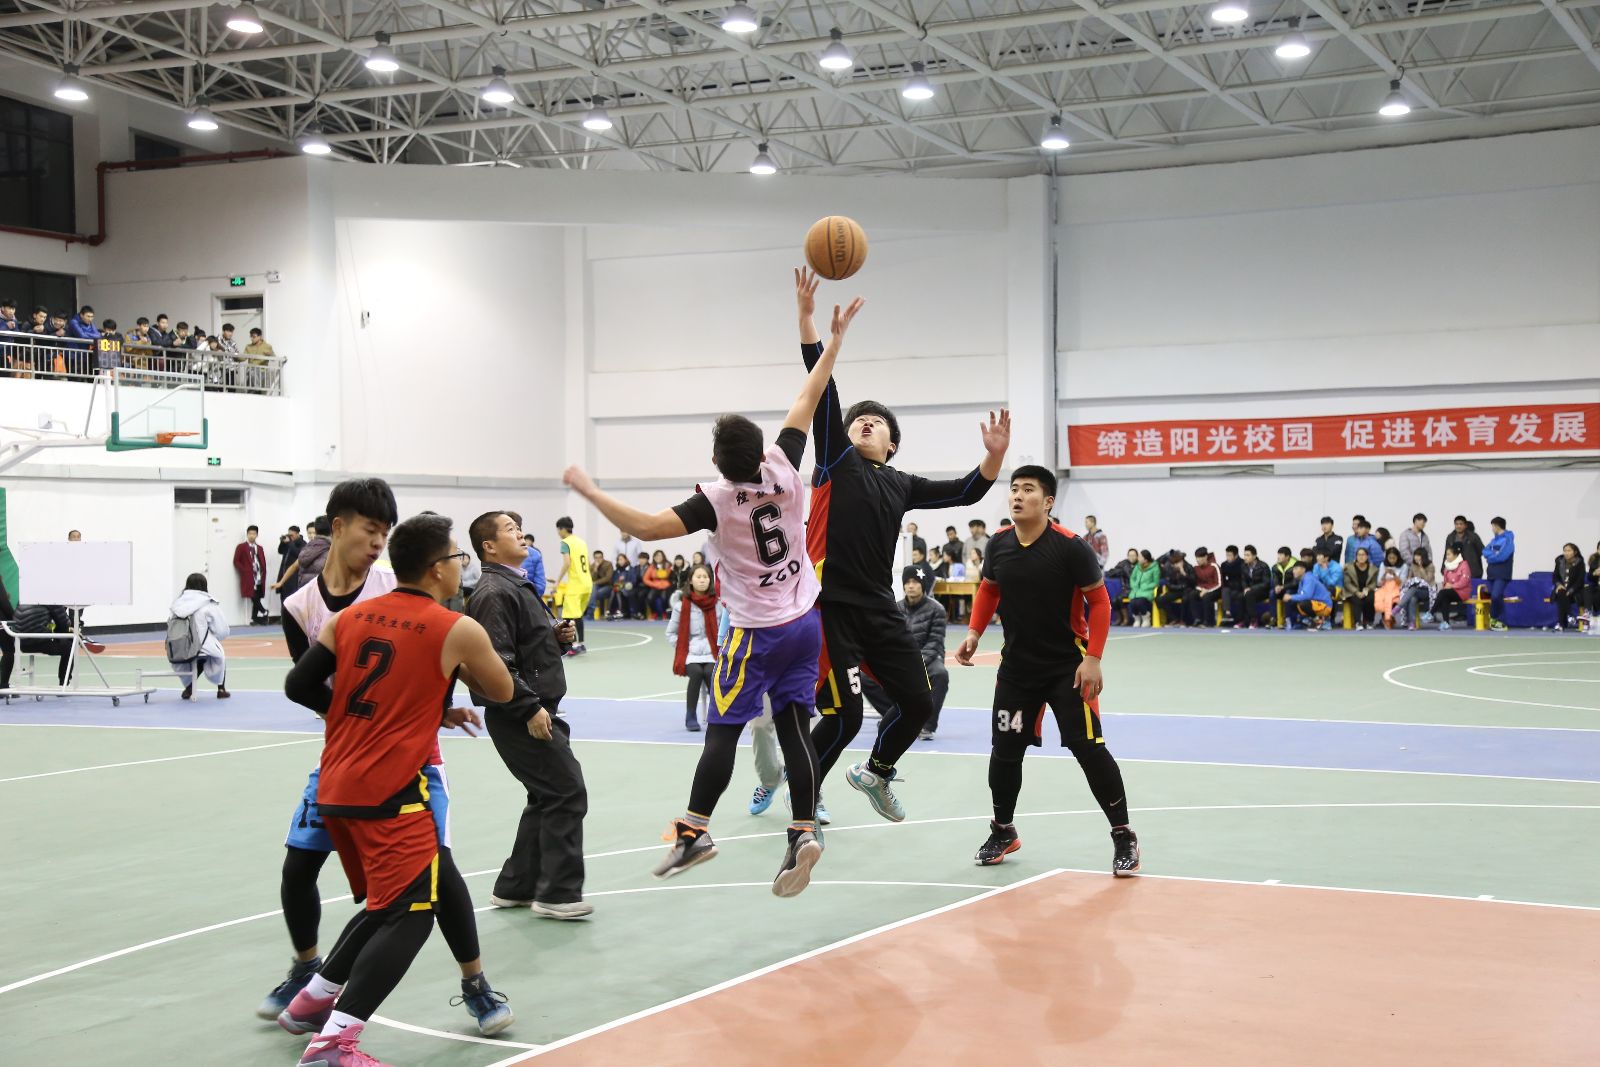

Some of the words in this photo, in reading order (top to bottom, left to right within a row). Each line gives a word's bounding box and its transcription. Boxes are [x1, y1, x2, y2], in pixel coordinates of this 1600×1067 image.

[1097, 423, 1315, 459] 缔造阳光校园
[1341, 411, 1587, 450] 促进体育发展
[749, 501, 789, 568] 6
[580, 555, 587, 573] 8
[759, 560, 800, 587] ZGD
[345, 636, 396, 720] 2
[847, 666, 862, 695] 5
[997, 709, 1024, 734] 34
